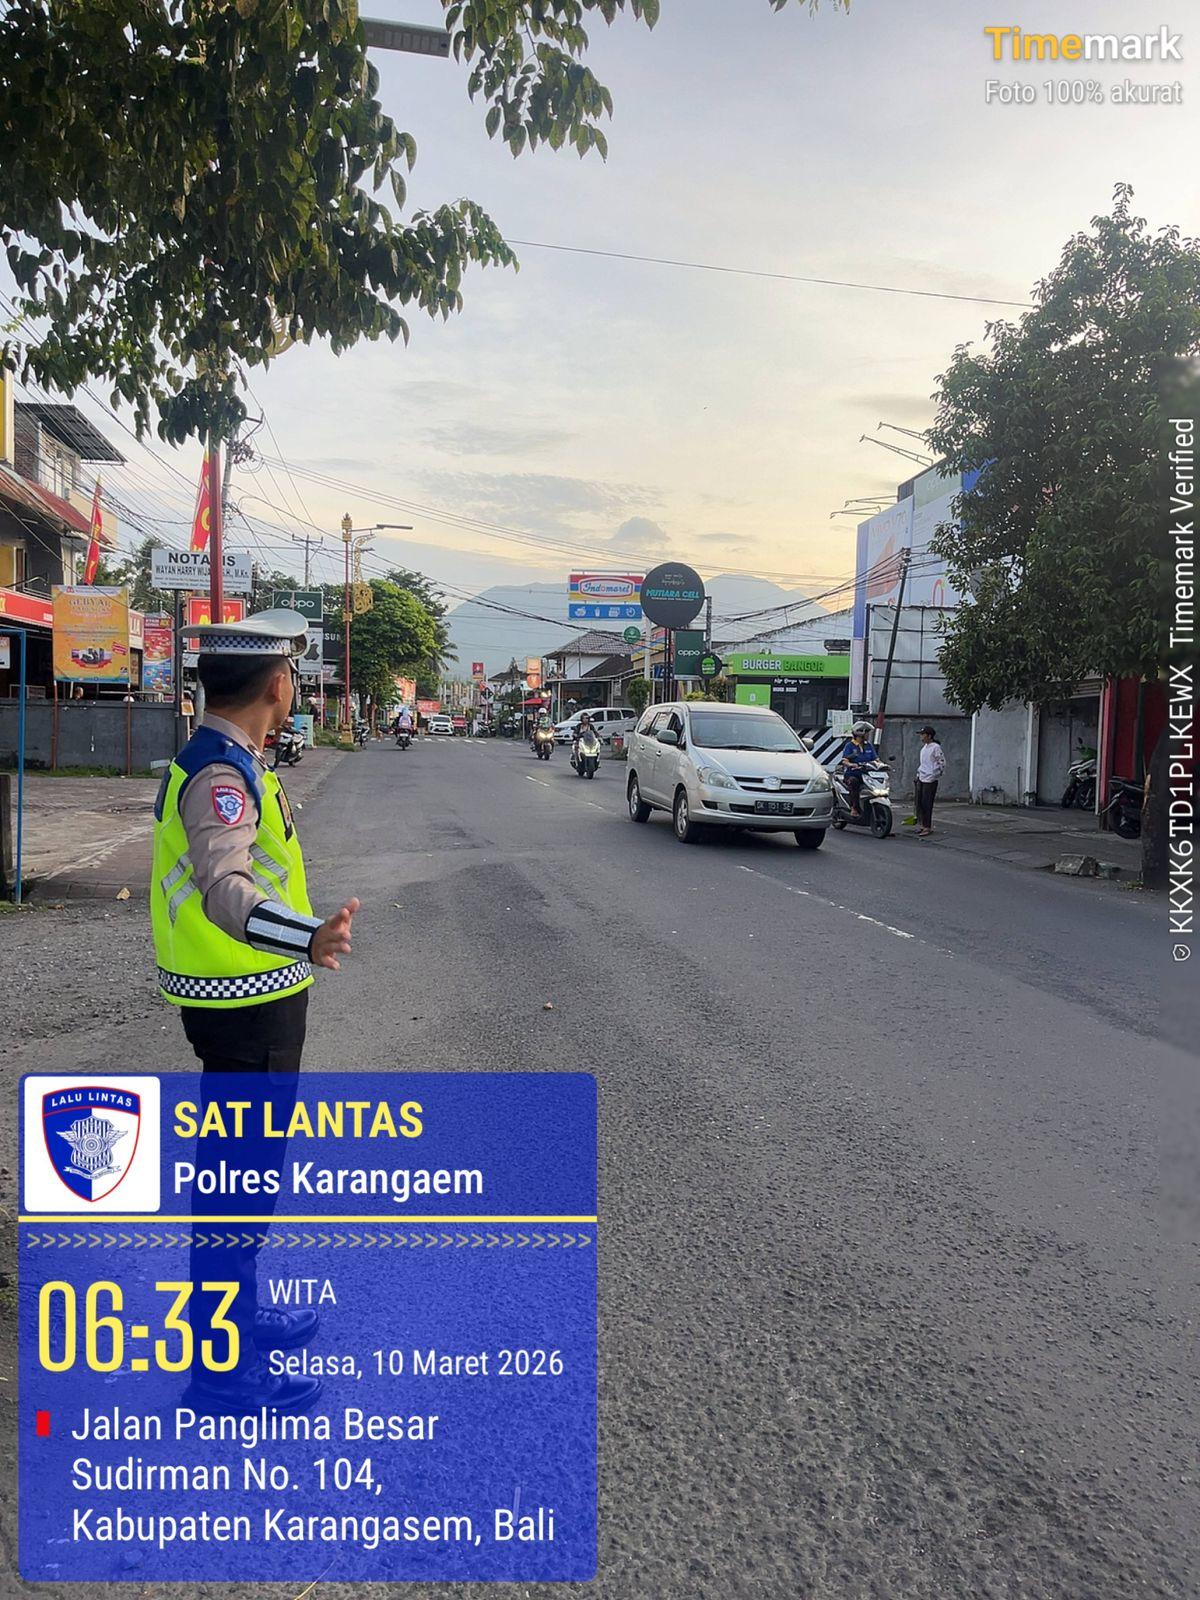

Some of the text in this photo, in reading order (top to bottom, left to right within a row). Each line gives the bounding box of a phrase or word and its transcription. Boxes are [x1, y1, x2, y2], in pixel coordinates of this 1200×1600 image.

[168, 553, 236, 567] NOTAIS
[177, 566, 197, 576] HARRY
[583, 582, 630, 593] Indomaret
[646, 588, 700, 599] MUTIARA CELL
[677, 649, 701, 657] oppo
[742, 659, 824, 672] BURGER BANGOR
